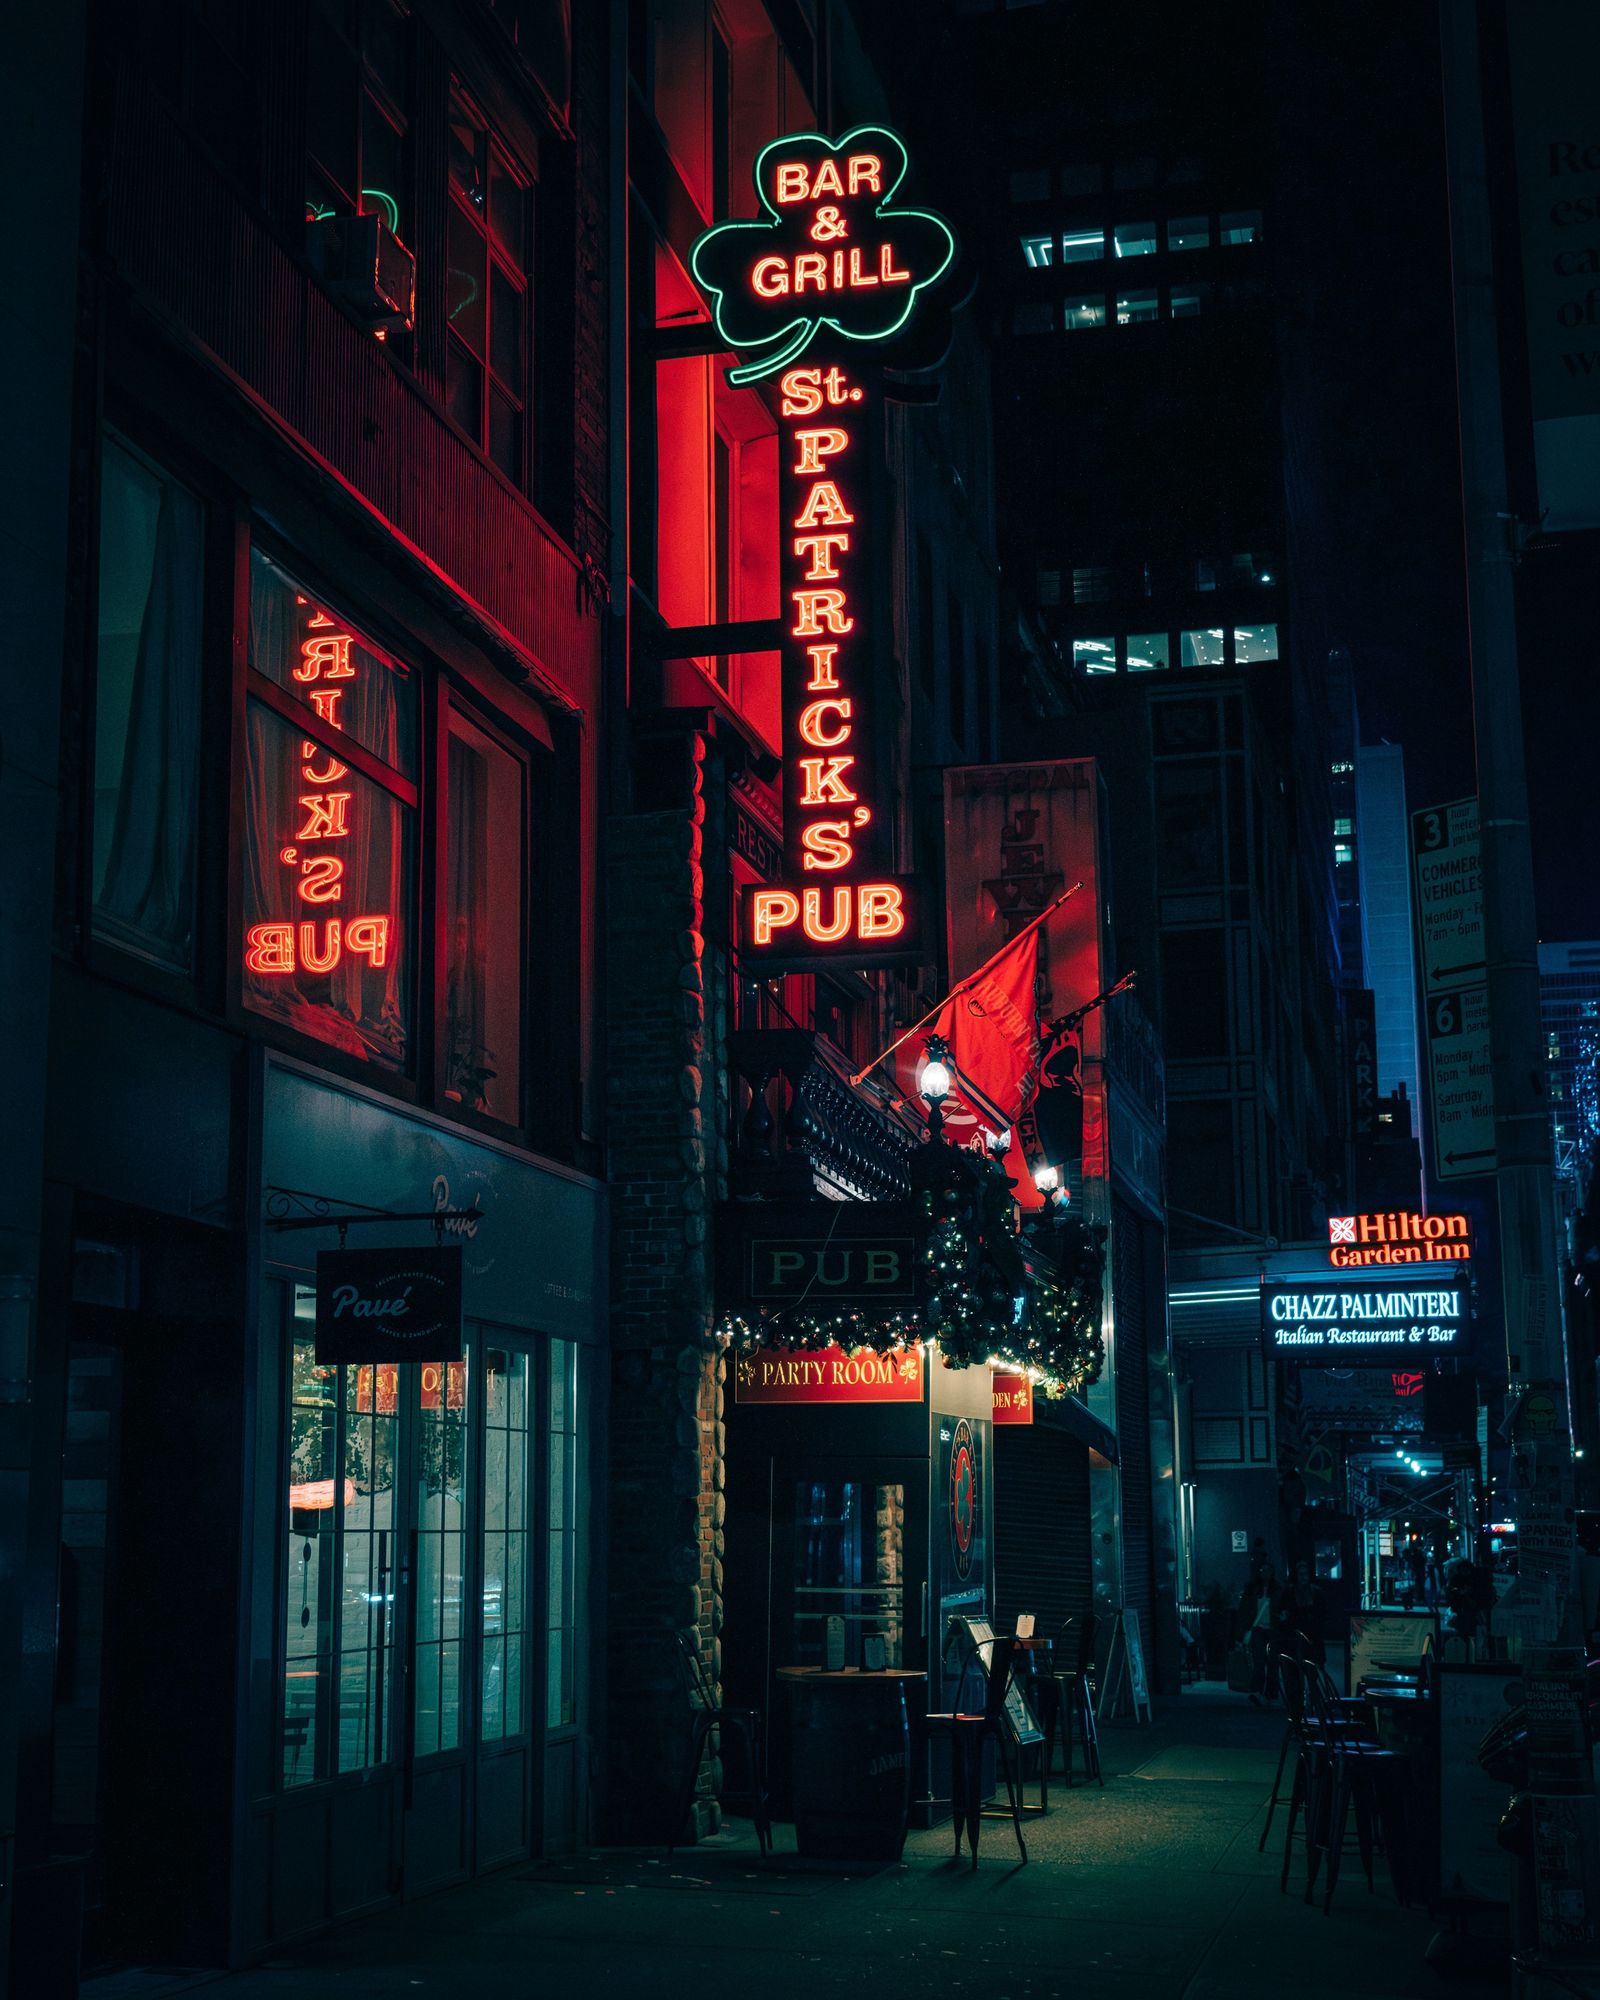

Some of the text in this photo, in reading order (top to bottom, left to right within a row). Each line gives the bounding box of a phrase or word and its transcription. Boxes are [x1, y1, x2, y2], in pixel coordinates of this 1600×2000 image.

[776, 154, 883, 204] BAR
[811, 206, 848, 241] &
[752, 244, 911, 299] GRILL
[779, 366, 864, 417] St.
[792, 427, 871, 872] PATRICK'S
[1423, 813, 1443, 848] 3
[753, 884, 905, 945] PUB
[1425, 906, 1465, 928] Monday
[1426, 927, 1449, 942] 7am
[1458, 921, 1481, 937] 6pm
[1435, 997, 1455, 1034] 6
[1435, 1049, 1473, 1066] Monday
[1437, 1068, 1459, 1084] 6pm
[1438, 1089, 1483, 1107] Saturday
[1439, 1109, 1463, 1123] 8am
[1360, 1211, 1469, 1243] Hilton
[769, 1250, 902, 1287] PUB
[1330, 1240, 1470, 1267] Garden Inn
[332, 1284, 413, 1319] Pavé
[1271, 1290, 1460, 1321] CHAZZ PALMINTERI
[1274, 1325, 1457, 1345] Italian Restaurant & Bar
[762, 1357, 894, 1386] PARTY ROOM
[1519, 1524, 1572, 1539] SPANISH
[1519, 1537, 1544, 1546] WITH
